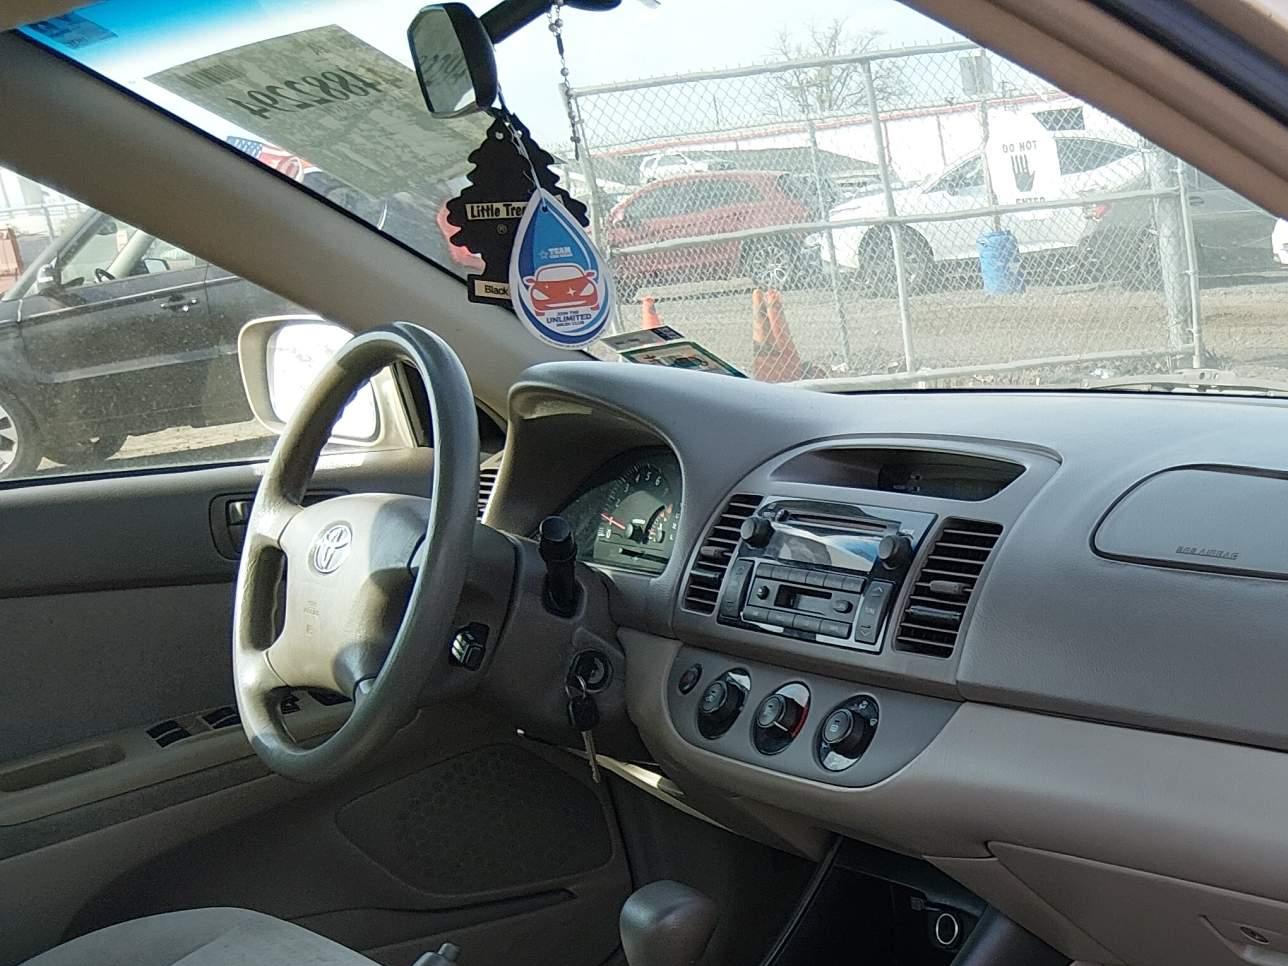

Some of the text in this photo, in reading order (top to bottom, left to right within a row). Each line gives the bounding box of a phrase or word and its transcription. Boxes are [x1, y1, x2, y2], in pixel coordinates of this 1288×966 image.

[1002, 140, 1037, 153] DO NOT
[470, 205, 501, 219] Little
[484, 284, 508, 296] Black
[546, 313, 592, 324] UNLIMITED
